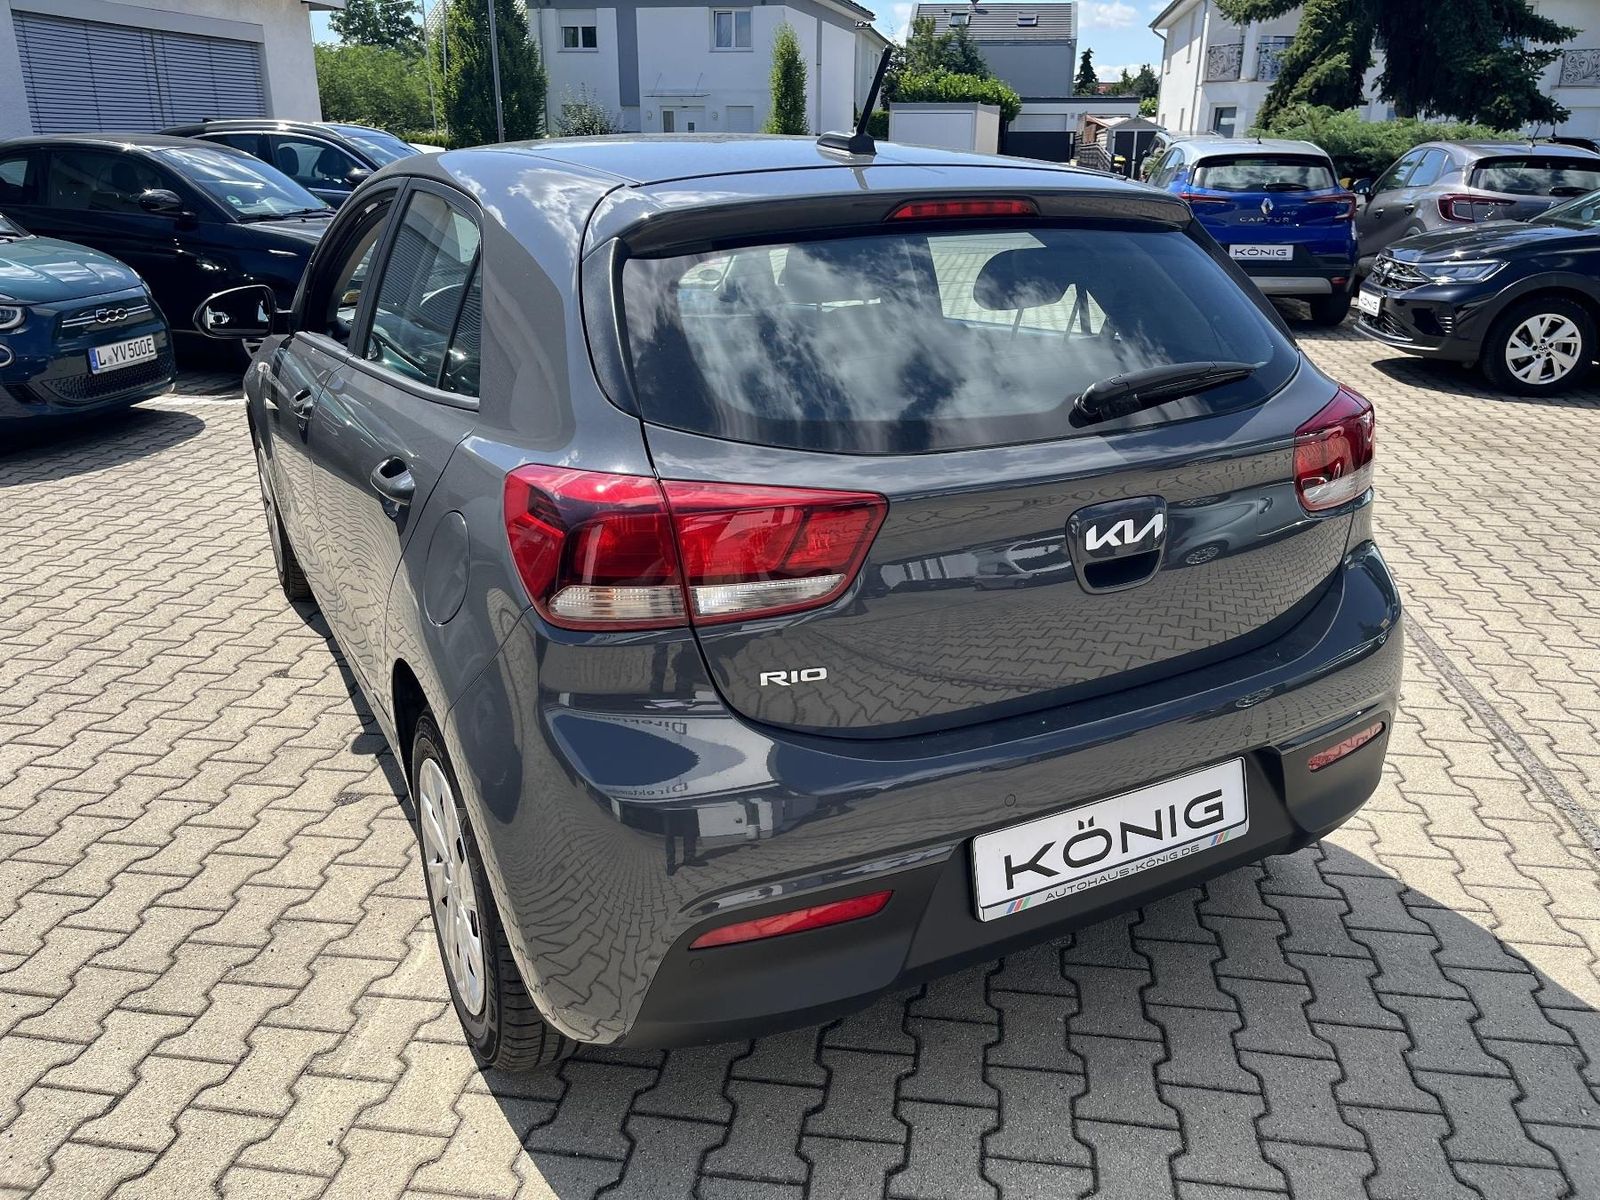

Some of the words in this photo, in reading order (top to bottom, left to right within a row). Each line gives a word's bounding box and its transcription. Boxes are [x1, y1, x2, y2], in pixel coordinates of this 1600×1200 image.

[1234, 246, 1288, 256] KÖNIG
[96, 308, 127, 323] 500
[1086, 513, 1164, 551] KIA
[760, 667, 827, 686] RIO
[1004, 788, 1225, 890] KÖNIG
